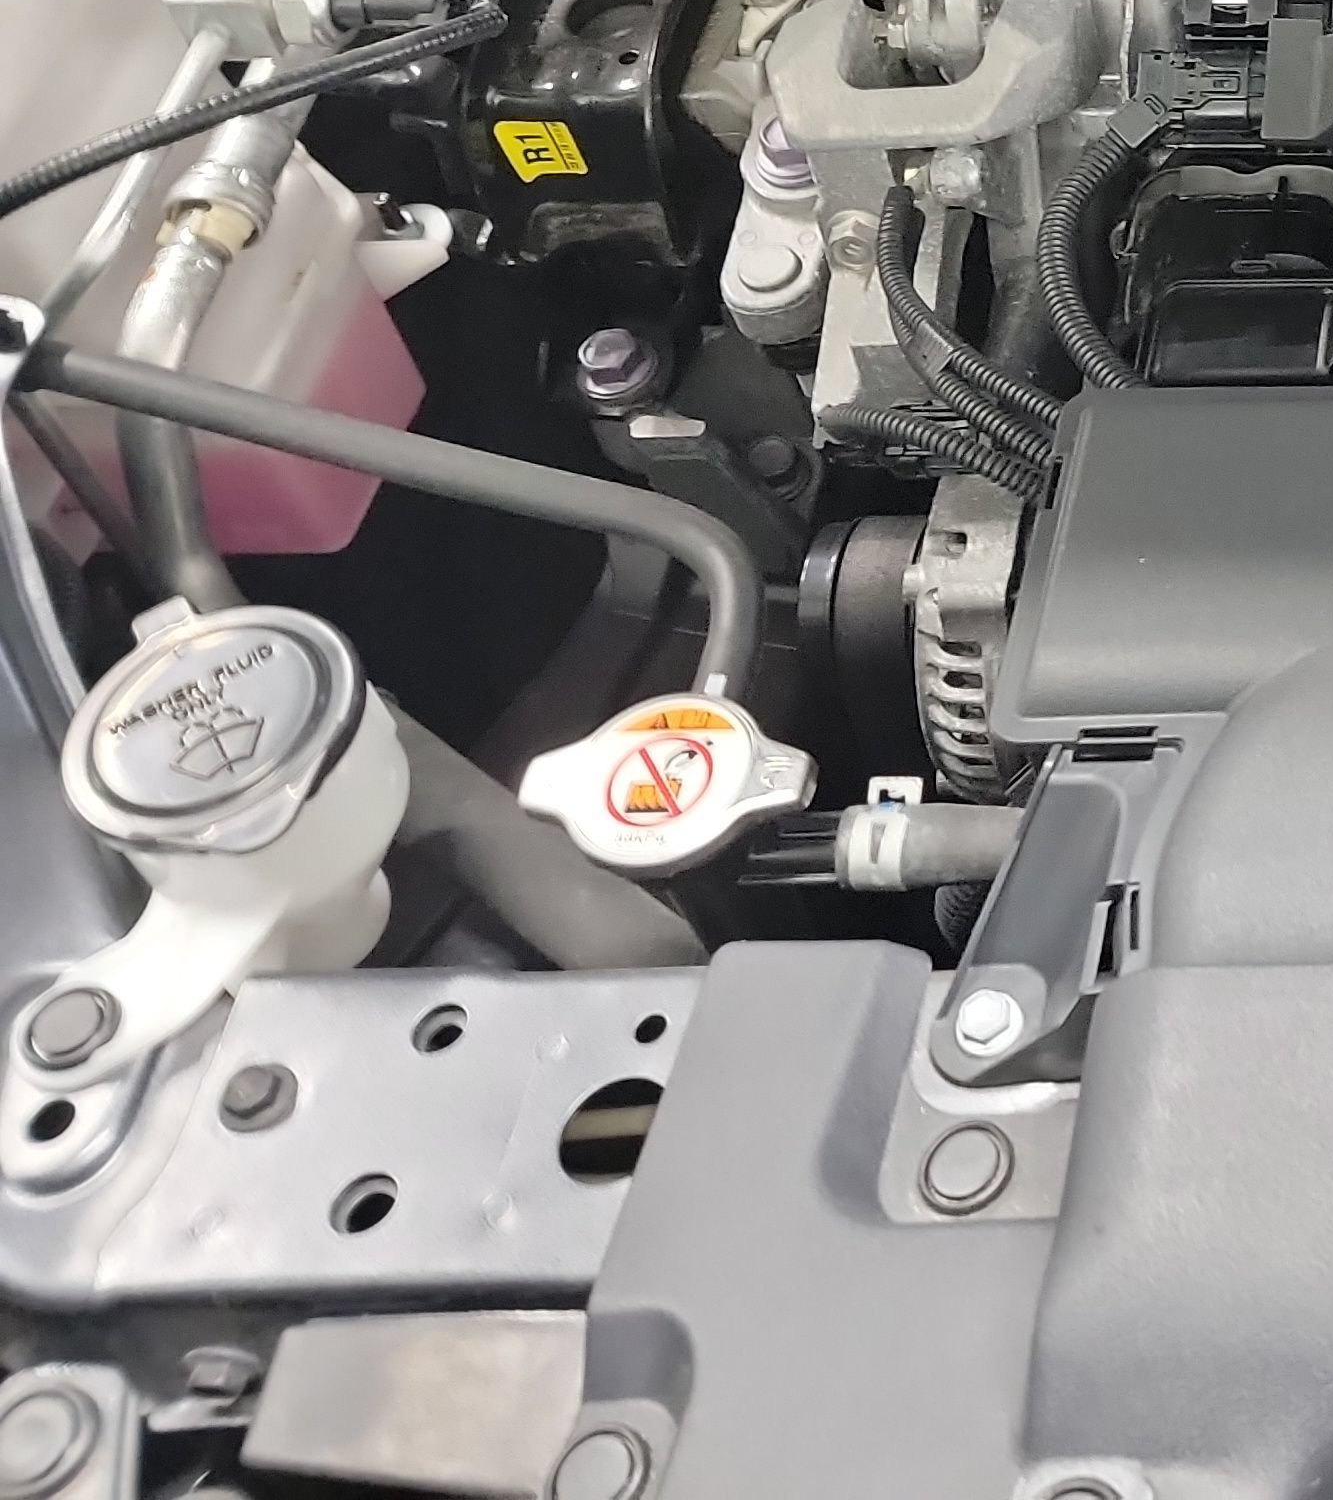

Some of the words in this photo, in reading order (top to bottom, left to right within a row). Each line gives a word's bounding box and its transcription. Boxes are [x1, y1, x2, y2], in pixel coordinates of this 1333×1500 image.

[514, 134, 554, 165] R1
[109, 680, 203, 736] WASHER
[215, 643, 276, 687] FLUID
